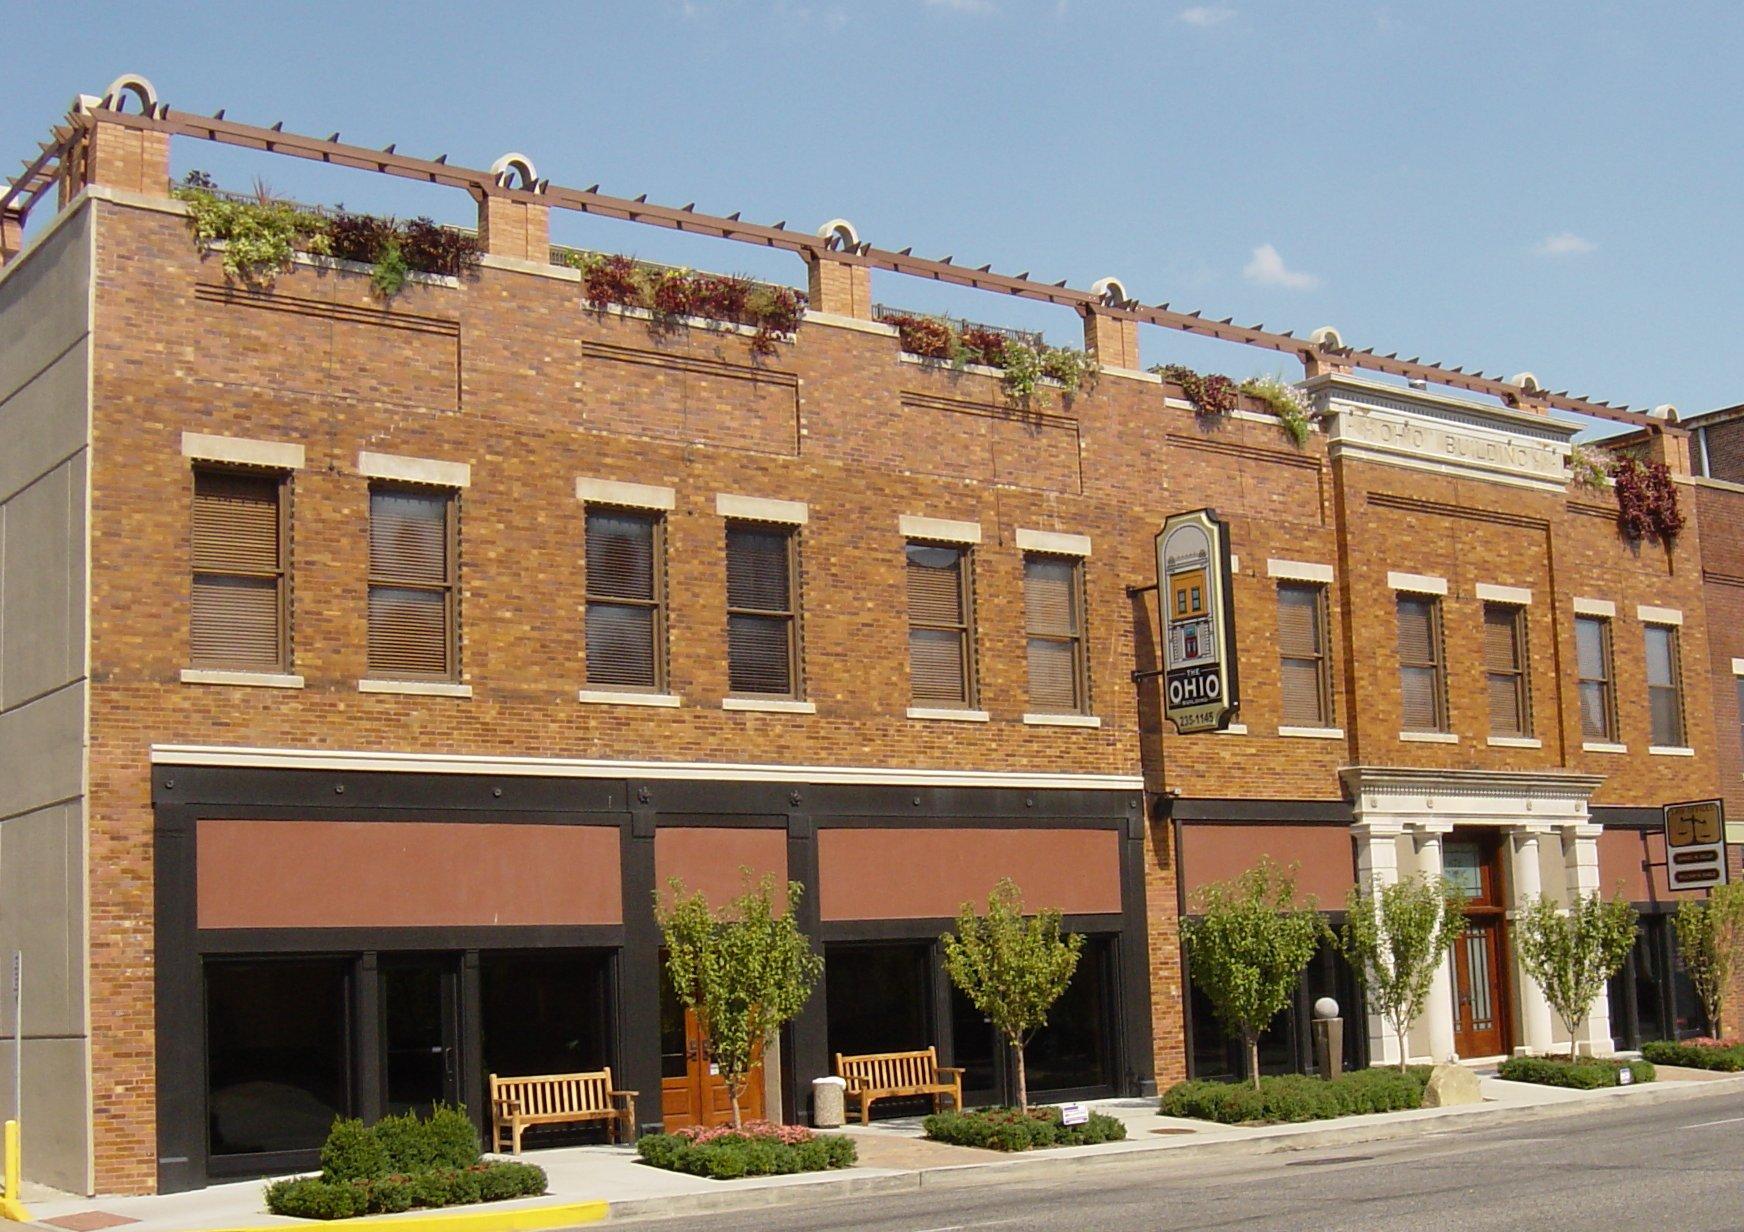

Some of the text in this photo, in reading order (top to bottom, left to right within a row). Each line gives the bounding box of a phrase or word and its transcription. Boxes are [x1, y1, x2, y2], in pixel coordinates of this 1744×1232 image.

[1380, 423, 1527, 467] OHIO BUILDING
[1169, 674, 1220, 704] OHIO
